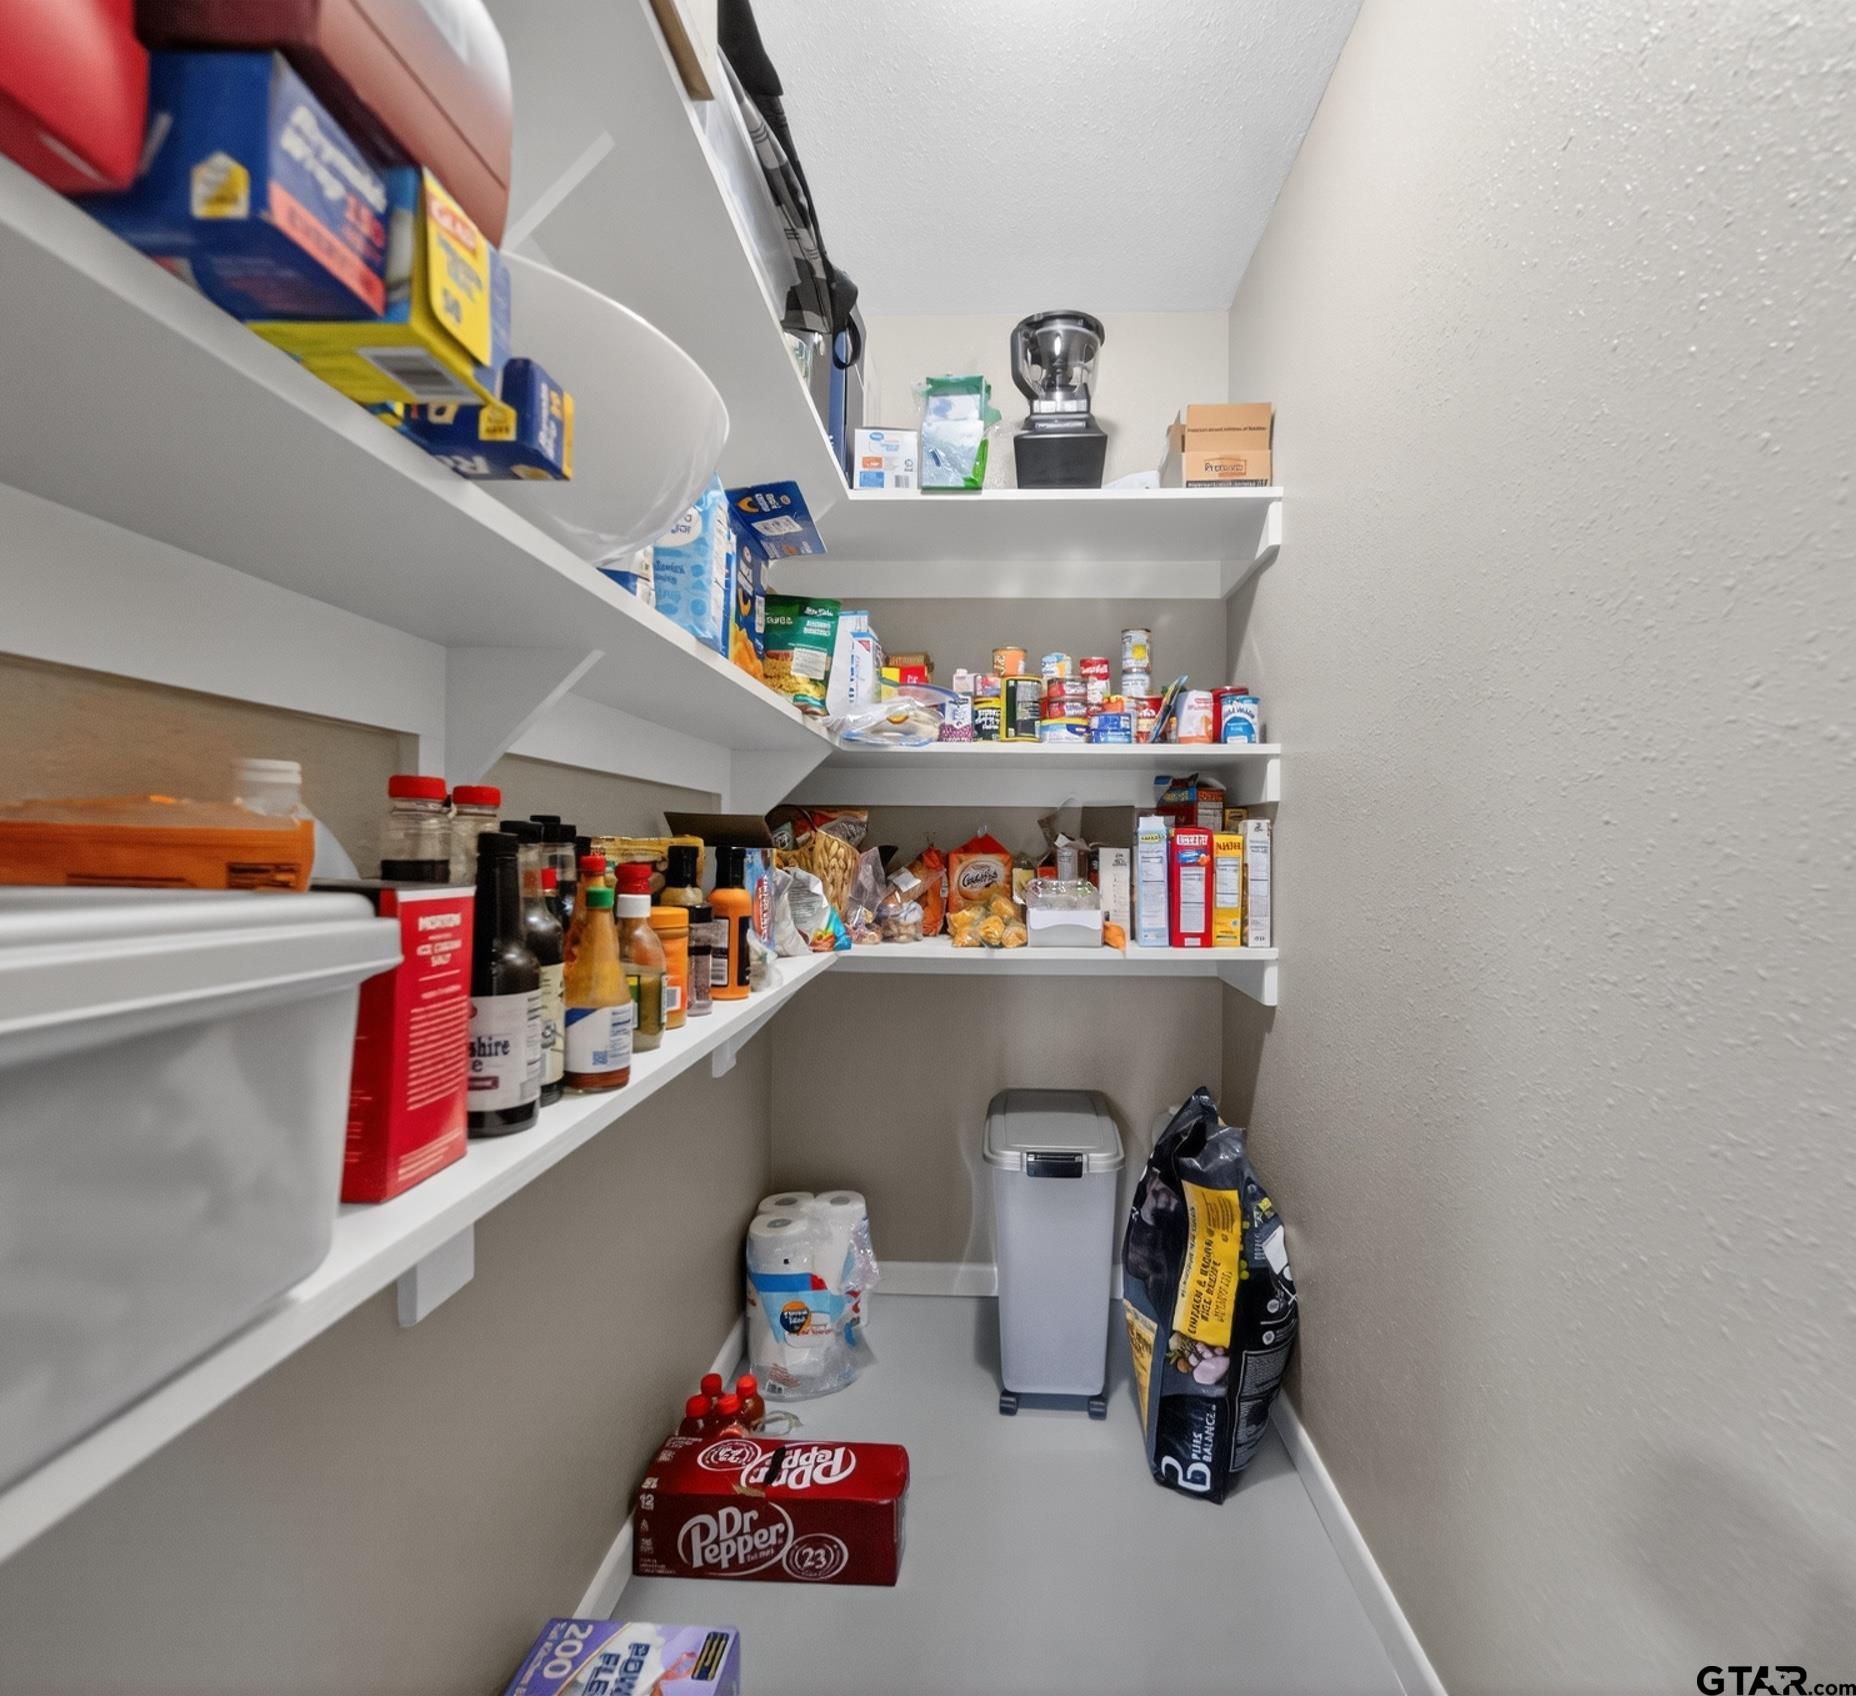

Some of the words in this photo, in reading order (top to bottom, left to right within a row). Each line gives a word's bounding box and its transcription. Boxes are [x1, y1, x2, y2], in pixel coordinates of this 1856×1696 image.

[687, 1513, 787, 1569] Pepper
[718, 1506, 759, 1540] Dr
[801, 1547, 828, 1569] 23
[542, 1624, 594, 1679] 200
